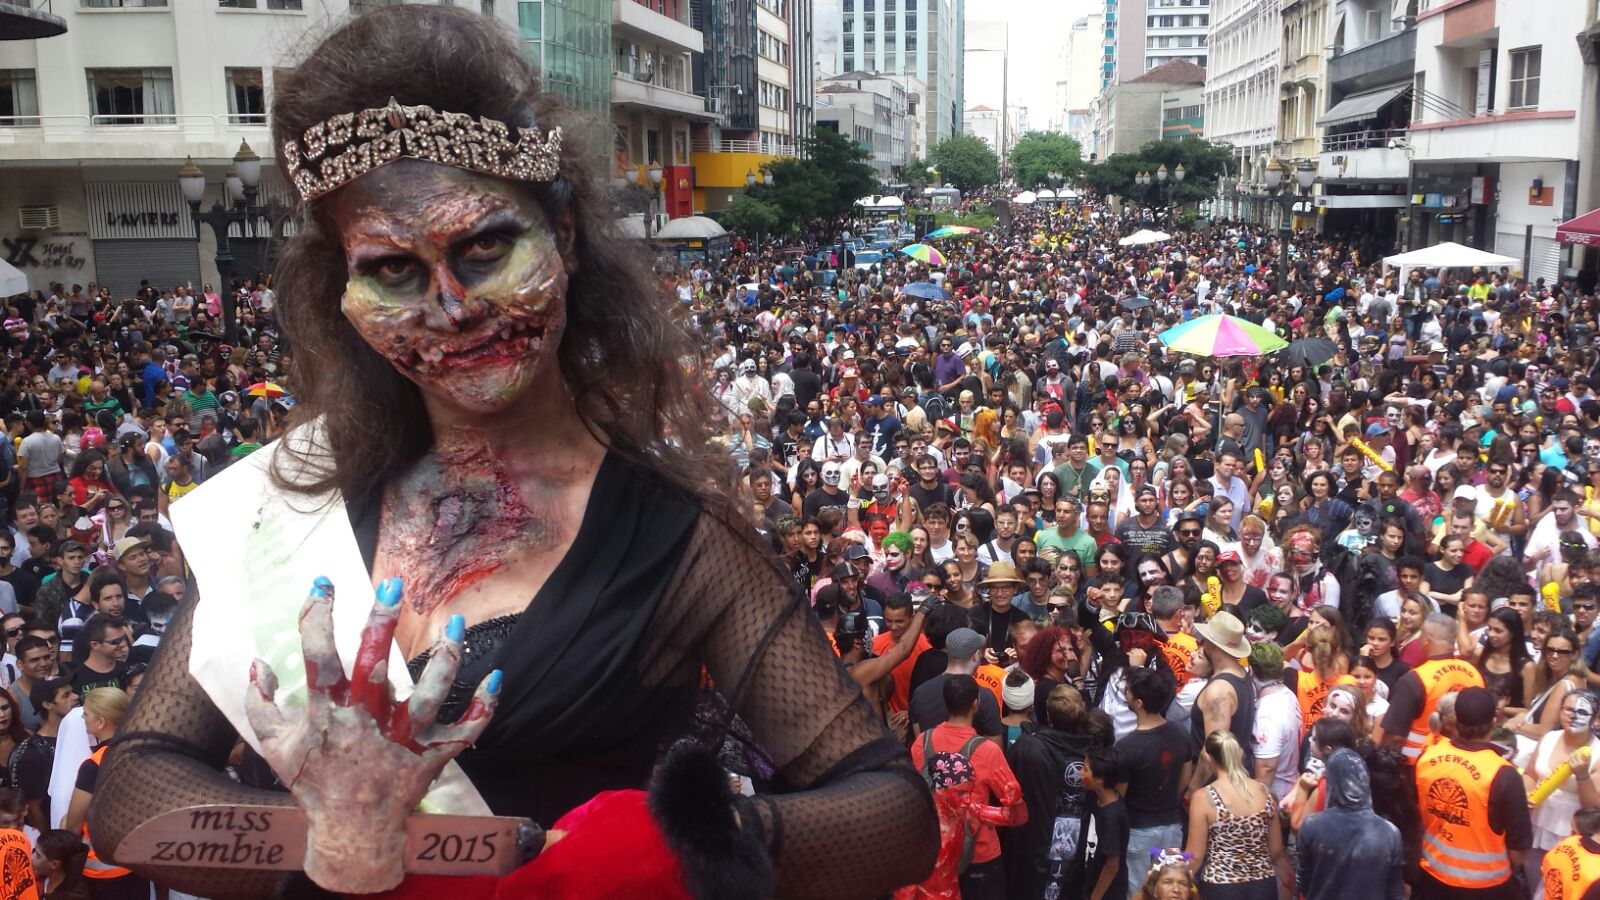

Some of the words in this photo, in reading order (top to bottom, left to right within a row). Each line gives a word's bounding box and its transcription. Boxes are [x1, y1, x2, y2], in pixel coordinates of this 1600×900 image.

[42, 241, 74, 255] Hotel
[1432, 664, 1474, 682] STEWARD
[1429, 754, 1481, 781] STEWARD
[190, 806, 273, 832] miss
[0, 834, 25, 850] WARD
[150, 832, 284, 865] zombie
[416, 831, 498, 863] 2015
